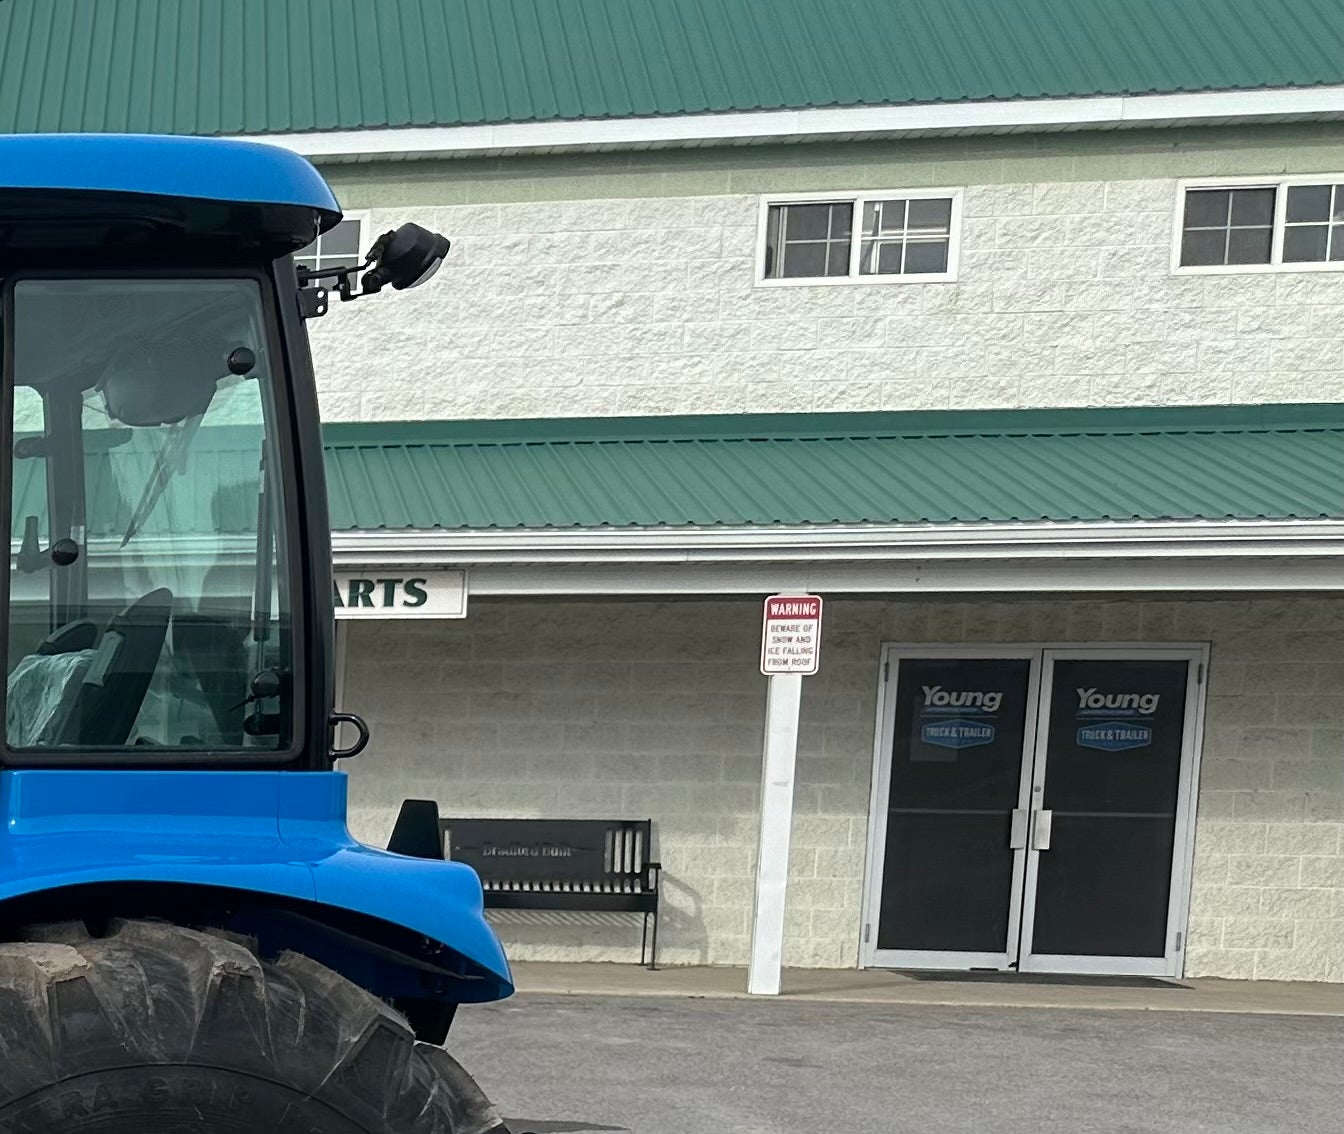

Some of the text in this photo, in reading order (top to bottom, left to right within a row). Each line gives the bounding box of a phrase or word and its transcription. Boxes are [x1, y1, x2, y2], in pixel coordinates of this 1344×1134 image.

[333, 577, 428, 608] ARTS
[770, 602, 817, 616] WARNING
[770, 624, 814, 633] BEWARE OF
[772, 636, 812, 644] SNOW AND
[768, 647, 814, 655] ICE FALLING
[768, 658, 812, 667] FROM ROOF
[921, 685, 1004, 712] Young
[1076, 687, 1161, 714] Young
[926, 727, 950, 737] TRUCK
[959, 727, 992, 738] TRAILER
[1081, 729, 1106, 740] TRUCK
[1114, 729, 1149, 740] TRAILER
